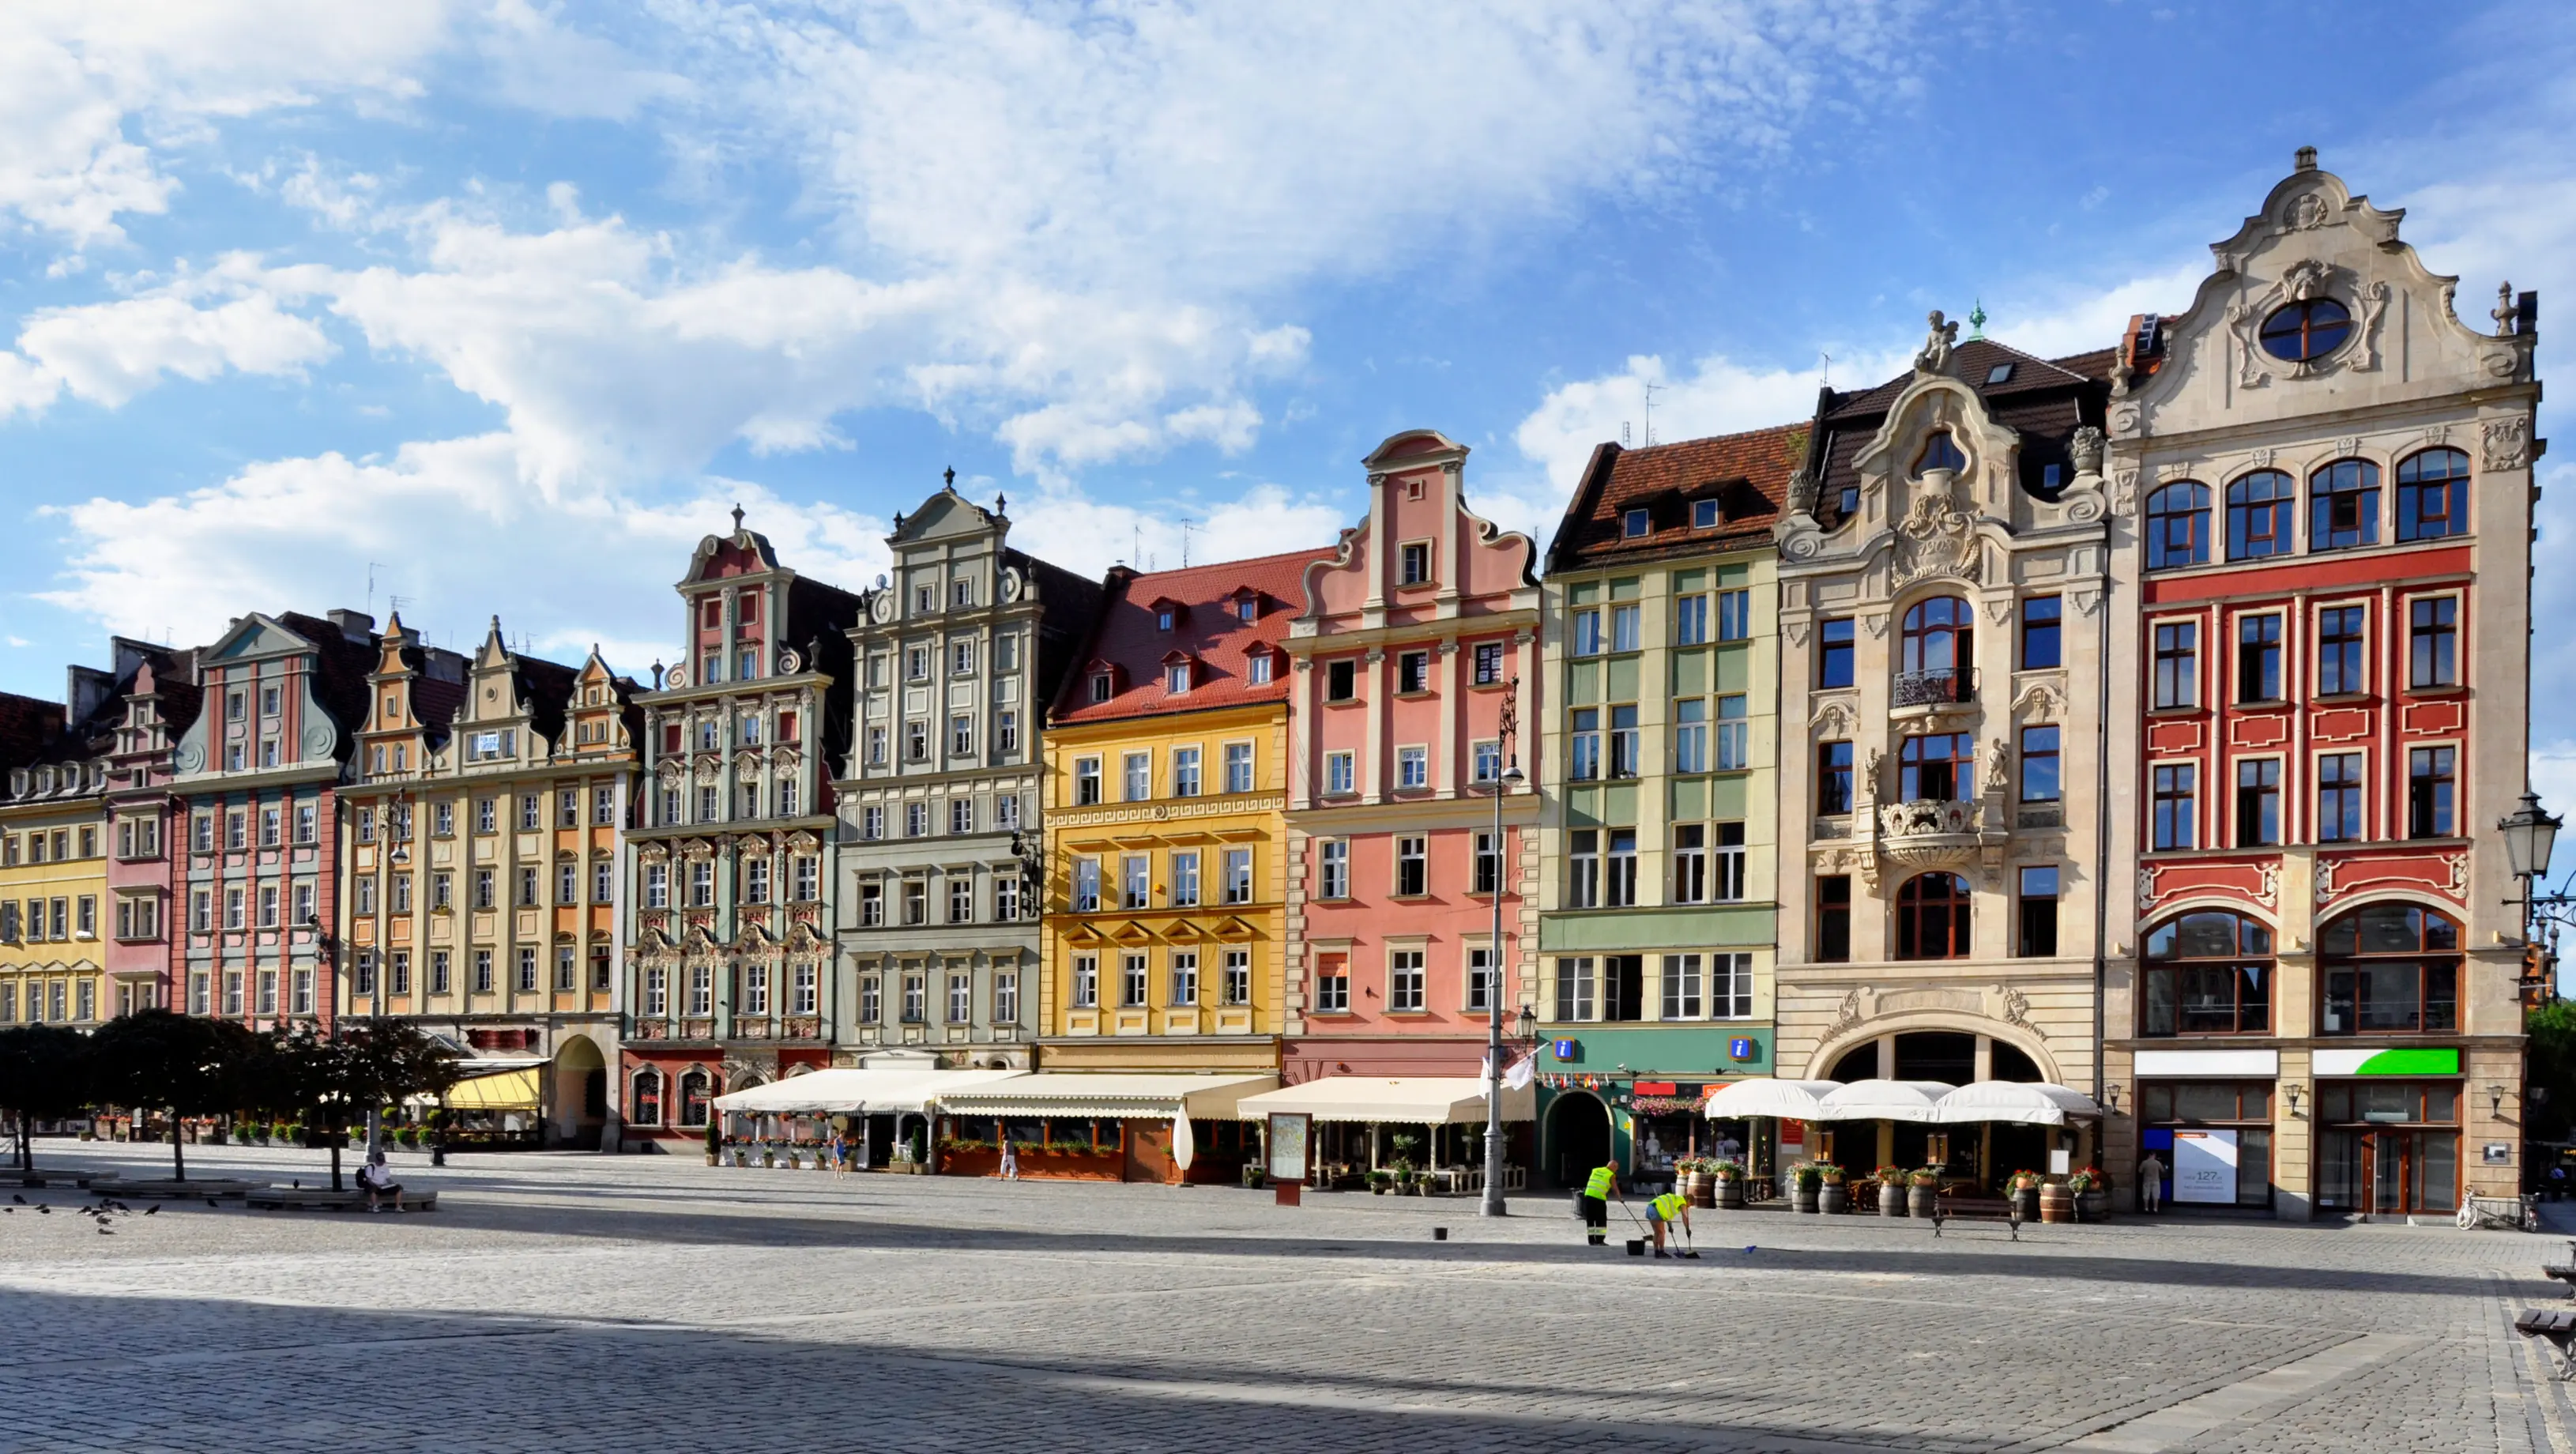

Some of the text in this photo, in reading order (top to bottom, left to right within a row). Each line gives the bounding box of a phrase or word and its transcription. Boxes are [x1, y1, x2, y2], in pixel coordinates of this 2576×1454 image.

[1414, 750, 1425, 759] SALE
[1560, 1041, 1566, 1057] i
[1736, 1040, 1743, 1057] i
[2197, 1171, 2217, 1181] 127
